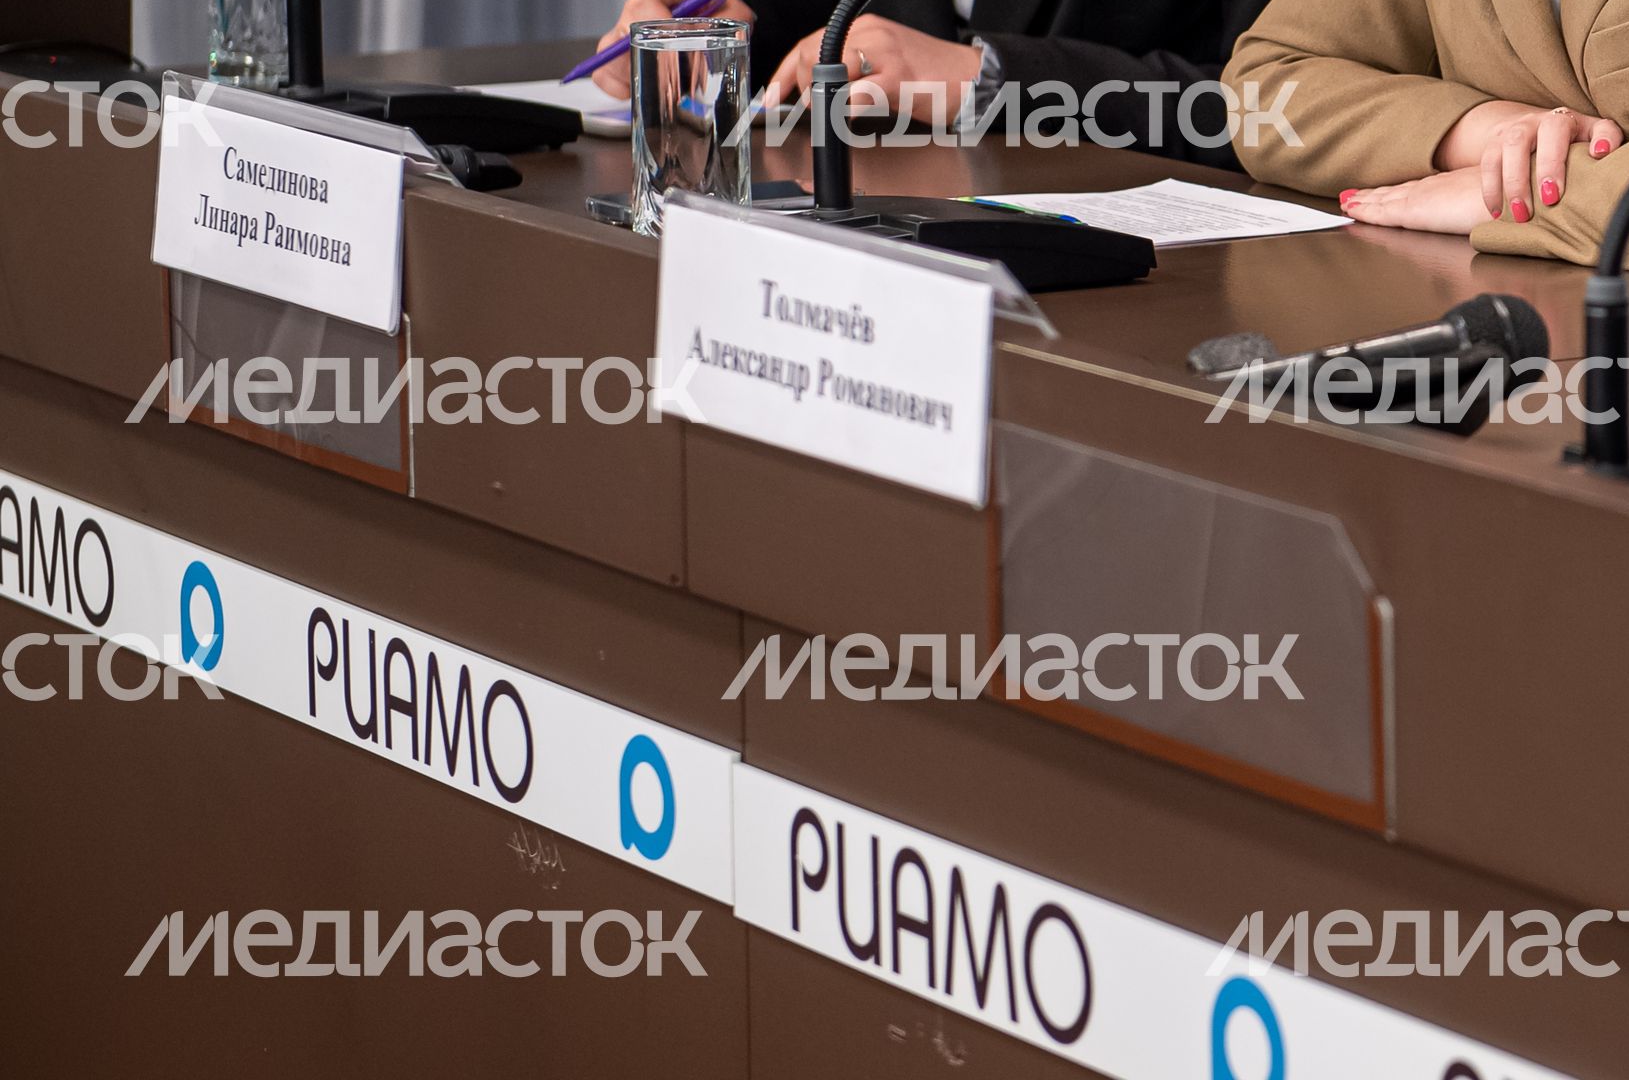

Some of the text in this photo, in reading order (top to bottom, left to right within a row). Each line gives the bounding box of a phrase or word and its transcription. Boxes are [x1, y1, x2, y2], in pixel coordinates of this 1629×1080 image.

[223, 146, 329, 204] Самединова
[193, 193, 351, 266] Линара Раимовна
[761, 278, 875, 345] Толмачёв
[688, 325, 954, 431] Александр Романович
